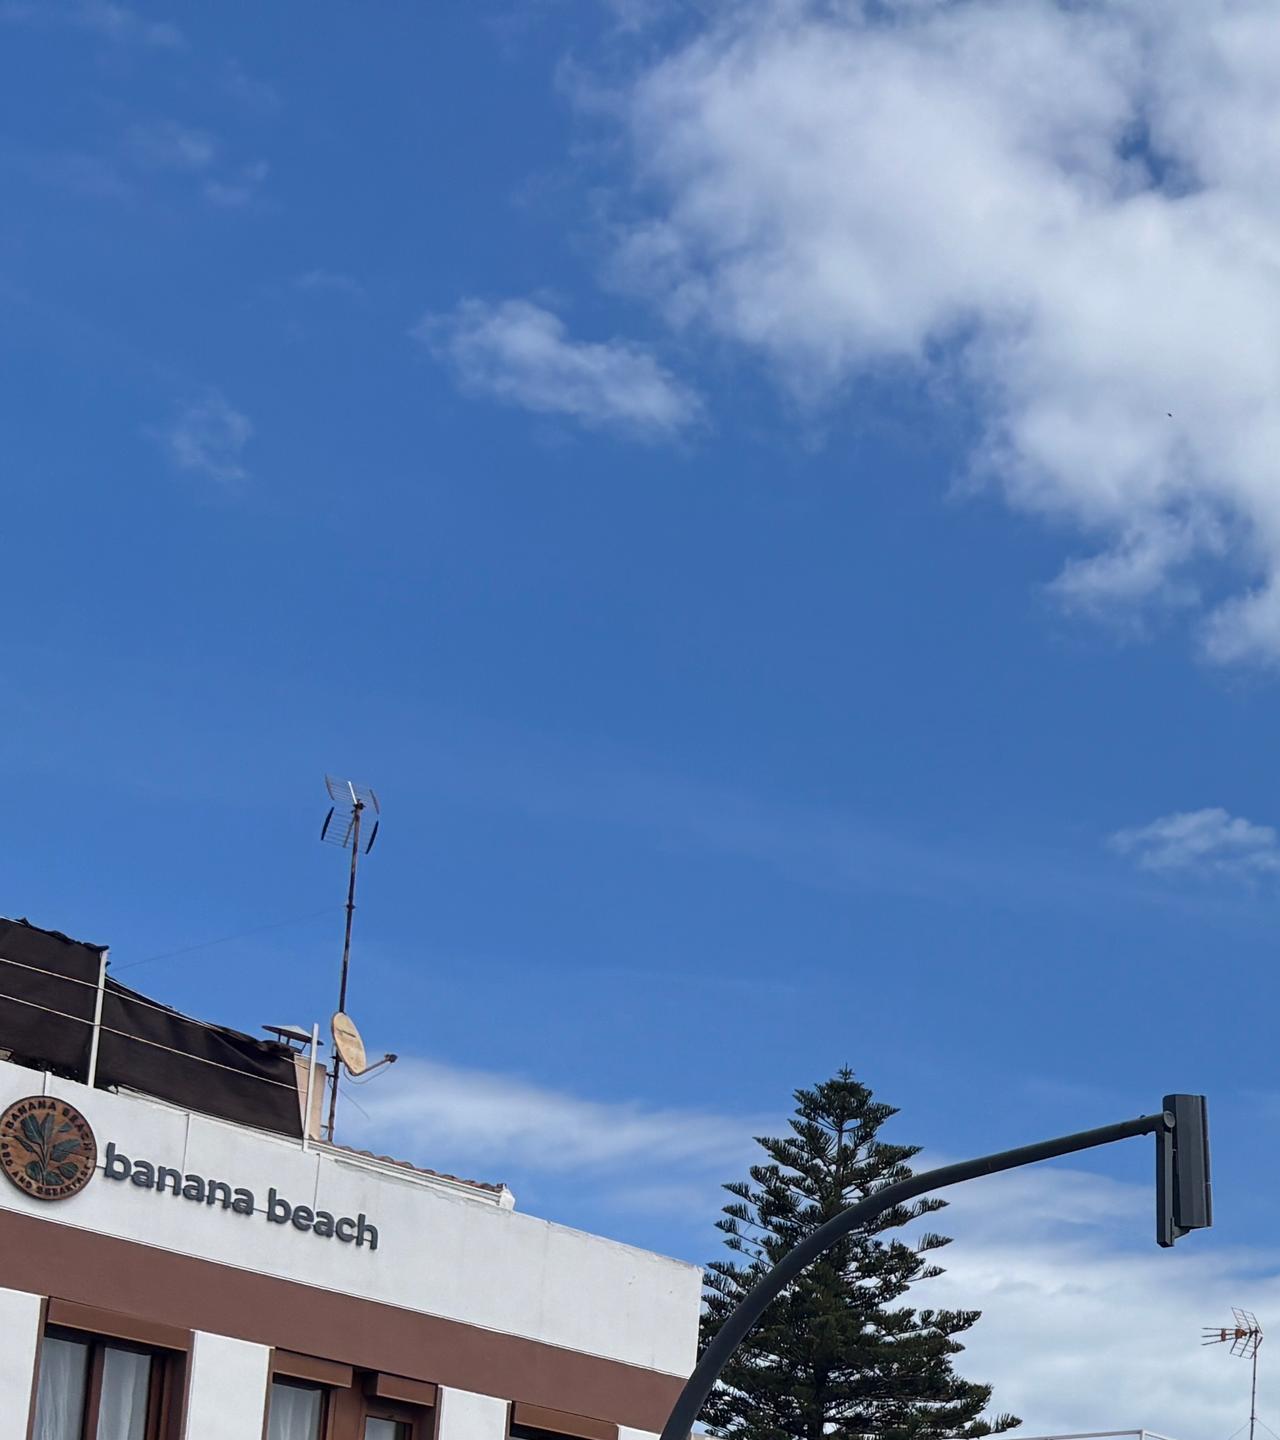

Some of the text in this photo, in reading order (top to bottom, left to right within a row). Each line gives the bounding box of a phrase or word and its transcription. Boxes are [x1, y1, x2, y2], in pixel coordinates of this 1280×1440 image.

[5, 1101, 57, 1129] BANANA
[104, 1142, 378, 1250] banana beach
